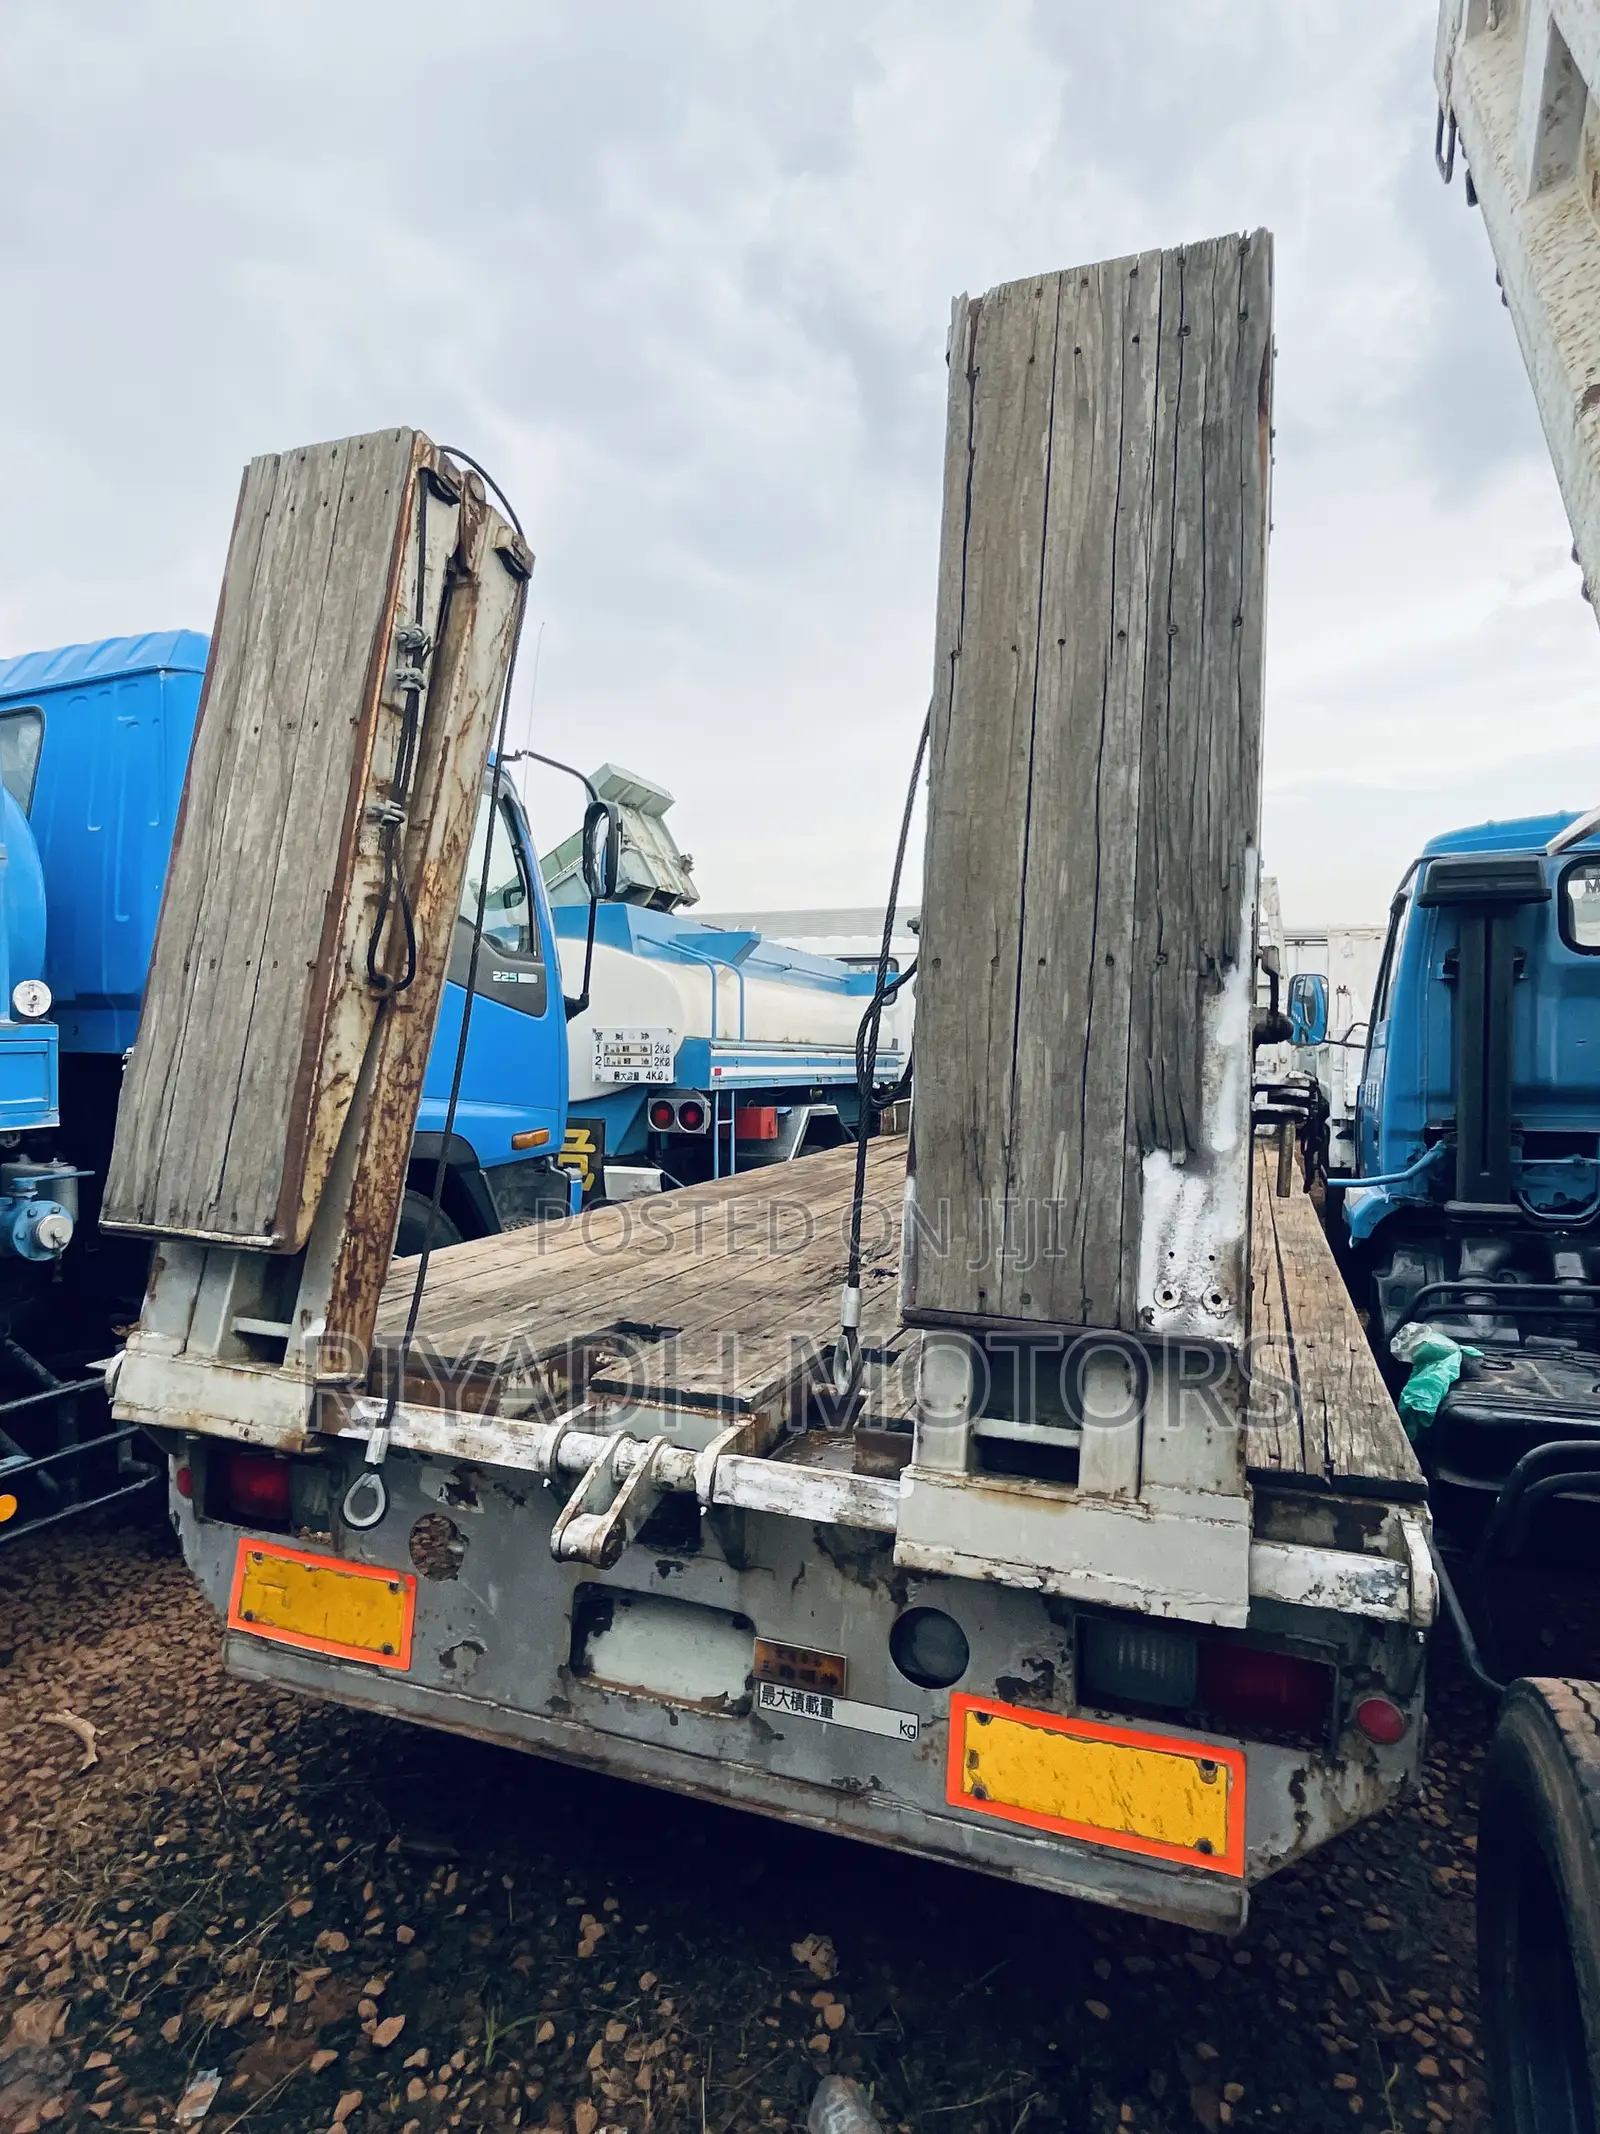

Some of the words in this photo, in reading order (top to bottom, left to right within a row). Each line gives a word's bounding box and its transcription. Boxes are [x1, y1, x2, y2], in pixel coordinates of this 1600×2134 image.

[492, 970, 518, 983] 225
[594, 1055, 602, 1066] 2
[761, 1685, 834, 1719] 最大積載量
[899, 1719, 917, 1740] kg
